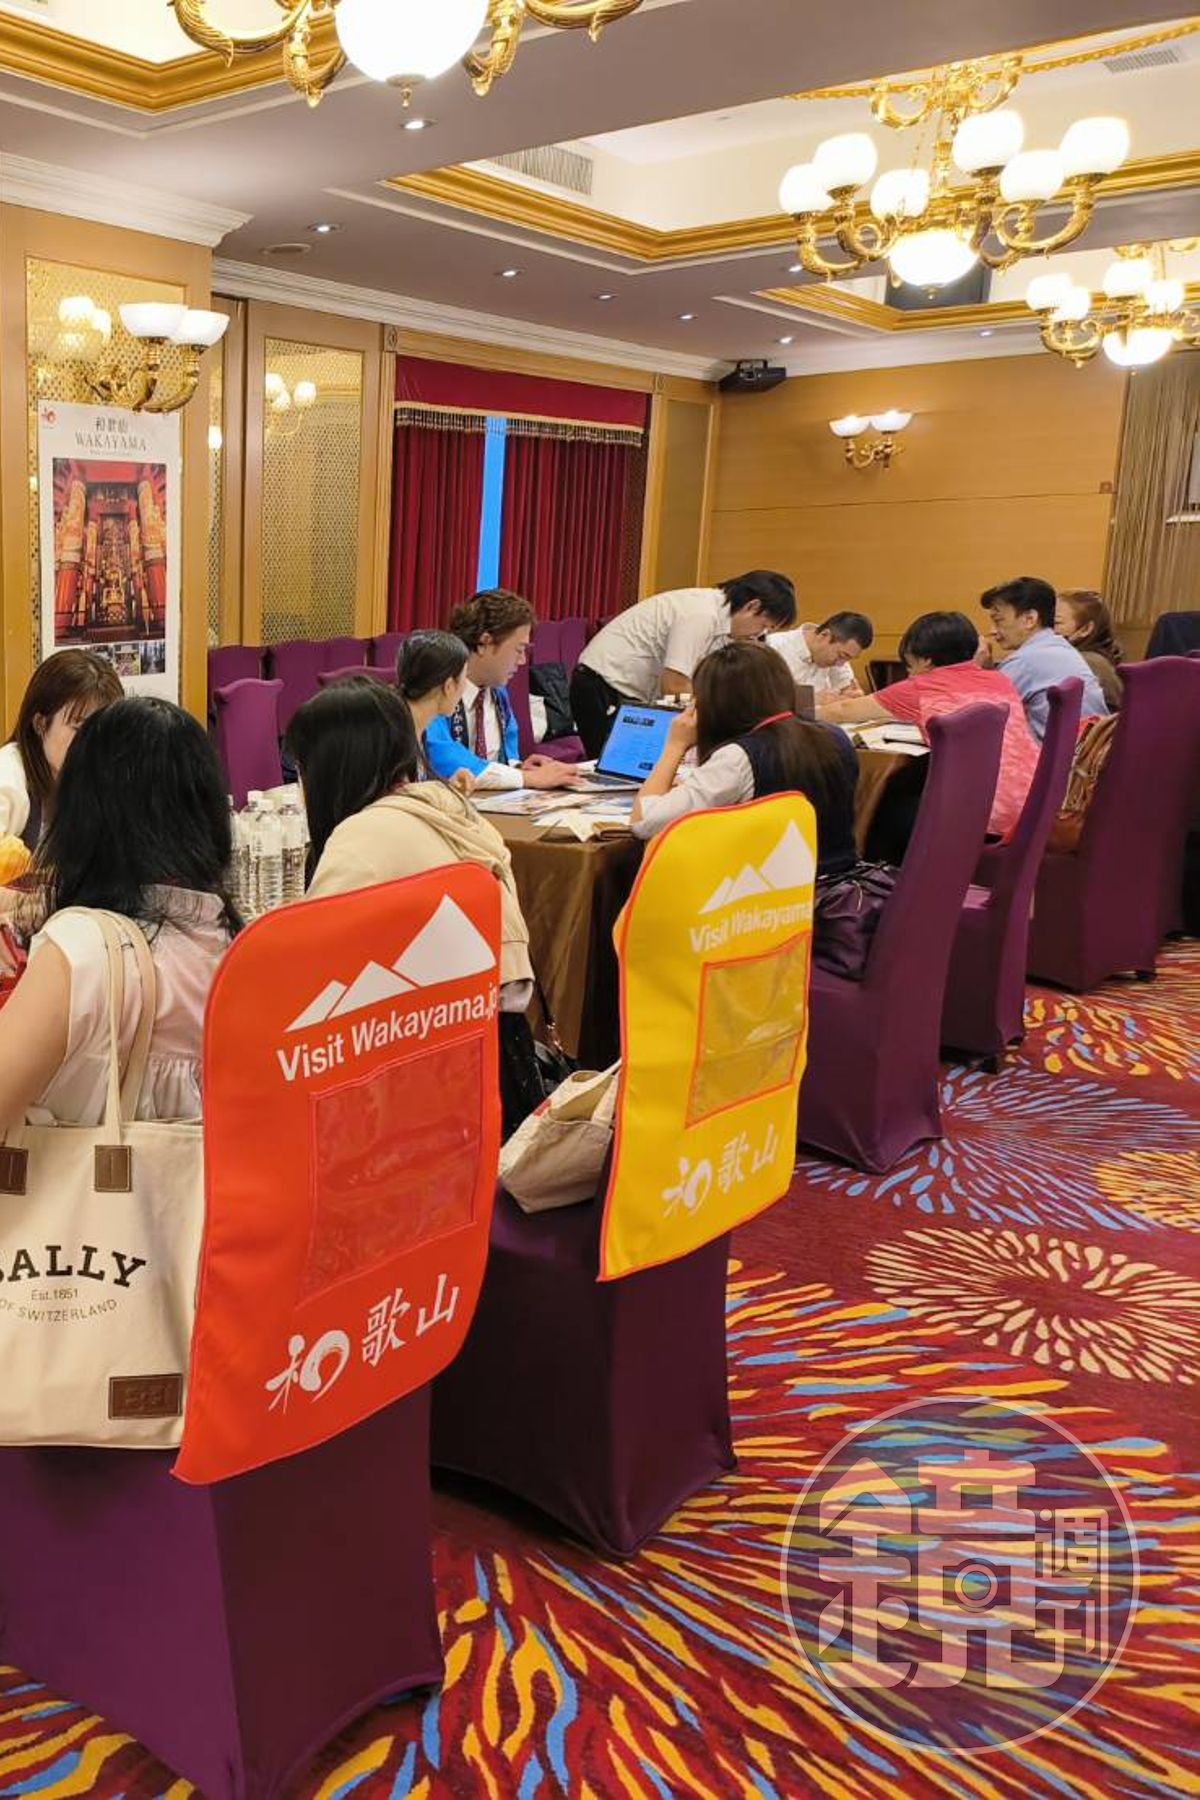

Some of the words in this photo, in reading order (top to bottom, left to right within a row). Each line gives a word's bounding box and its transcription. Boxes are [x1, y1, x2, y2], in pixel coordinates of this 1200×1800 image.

[75, 431, 147, 451] WAKAYAMA
[277, 1033, 345, 1082] Visit
[661, 1123, 779, 1219] 和歌山
[18, 1299, 118, 1322] SWITZERLAND
[266, 1274, 460, 1414] 和歌山
